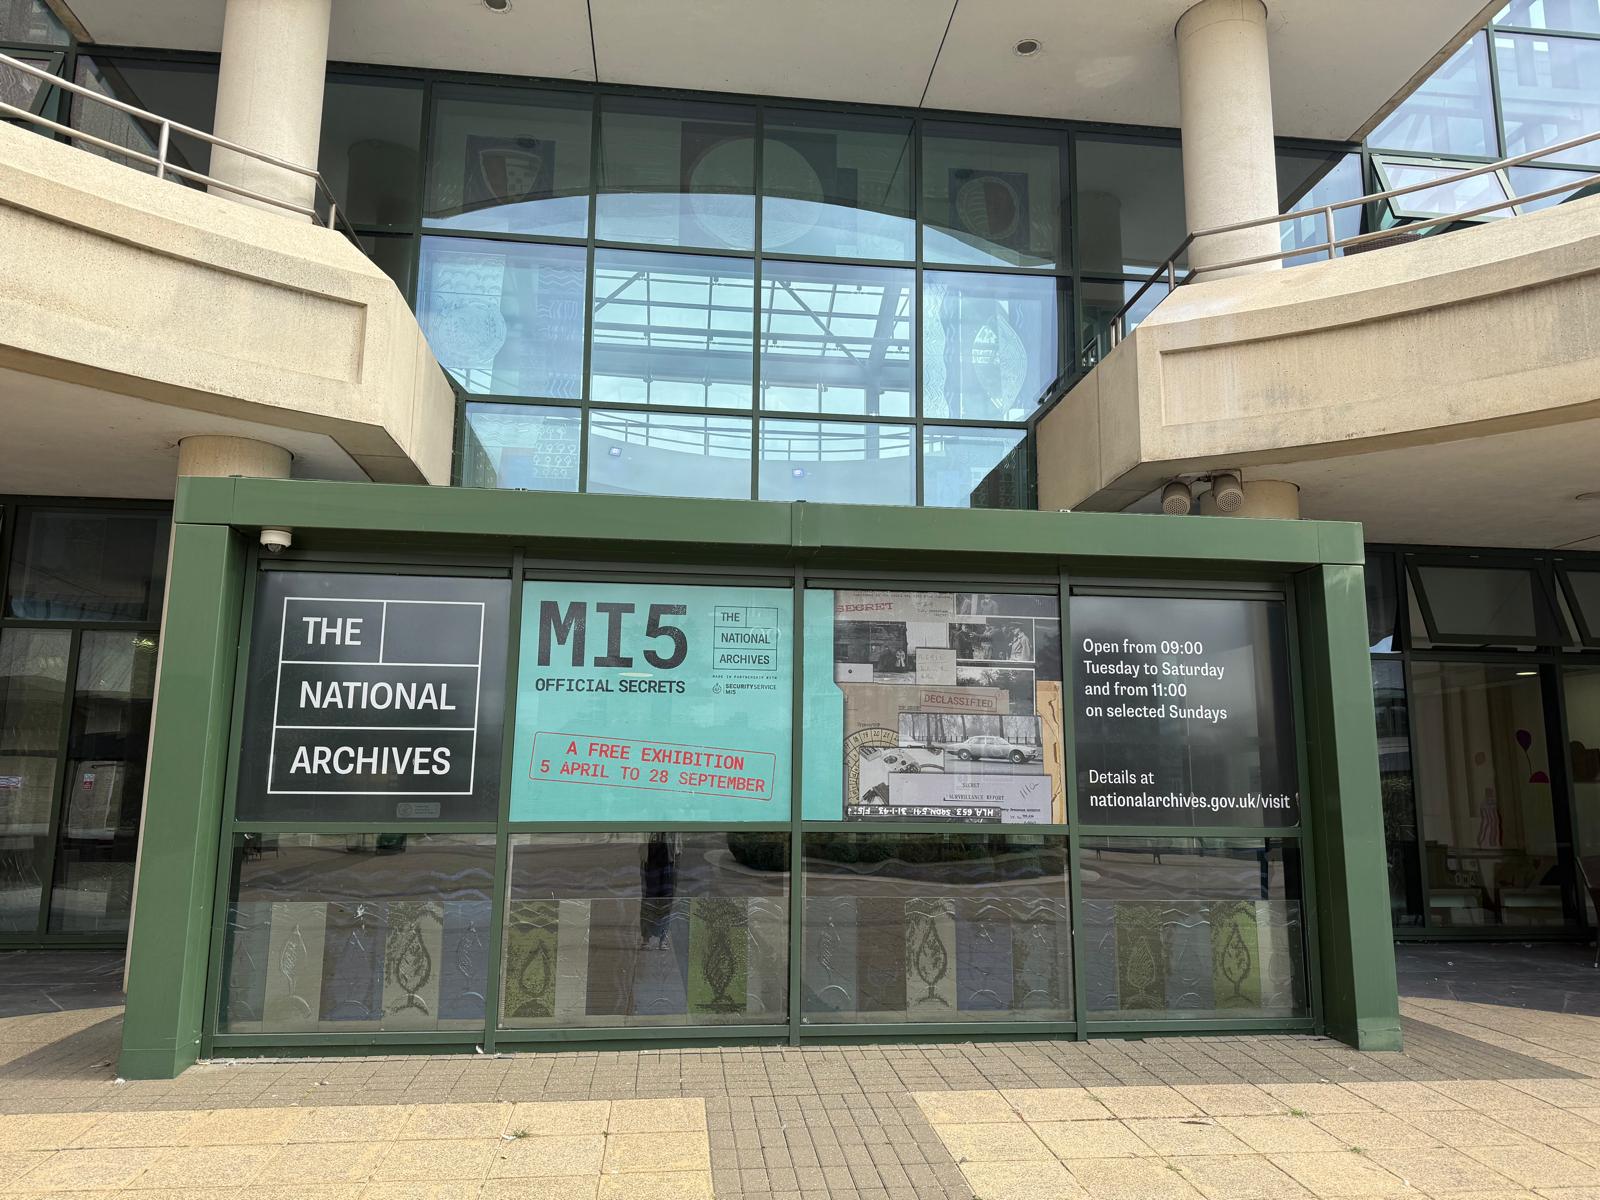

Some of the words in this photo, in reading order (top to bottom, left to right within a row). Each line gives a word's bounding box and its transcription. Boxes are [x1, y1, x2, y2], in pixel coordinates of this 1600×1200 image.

[836, 602, 893, 613] SECRET
[721, 612, 740, 622] THE
[302, 616, 363, 645] THE
[537, 600, 688, 669] MI5
[721, 632, 770, 644] NATIONAL
[1083, 638, 1119, 655] Open
[1122, 639, 1157, 654] from
[1160, 640, 1203, 655] 09:00
[719, 654, 770, 664] ARCHIVES
[1083, 660, 1140, 678] Tuesday
[1143, 663, 1158, 675] to
[1162, 661, 1225, 680] Saturday
[535, 678, 614, 692] OFFICIAL
[618, 679, 686, 694] SECRETS
[1084, 681, 1110, 696] and
[1113, 682, 1148, 696] from
[1151, 683, 1187, 697] 11:00
[299, 681, 456, 710] NATIONAL
[924, 694, 993, 708] DECLASSIFIED
[1085, 705, 1103, 717] on
[1106, 704, 1165, 718] selected
[1169, 704, 1228, 723] Sundays
[289, 745, 451, 775] ARCHIVES
[566, 741, 577, 755] A
[588, 742, 631, 760] FREE
[641, 747, 745, 770] EXHIBITION
[540, 759, 550, 773] 5
[560, 761, 609, 778] APRIL
[620, 766, 640, 780] TO
[649, 768, 669, 783] 28
[679, 771, 765, 792] SEPTEMBER
[1089, 769, 1137, 784] Details
[1140, 771, 1155, 785] at
[1090, 792, 1291, 811] nationalarchives.gov.uk/visit
